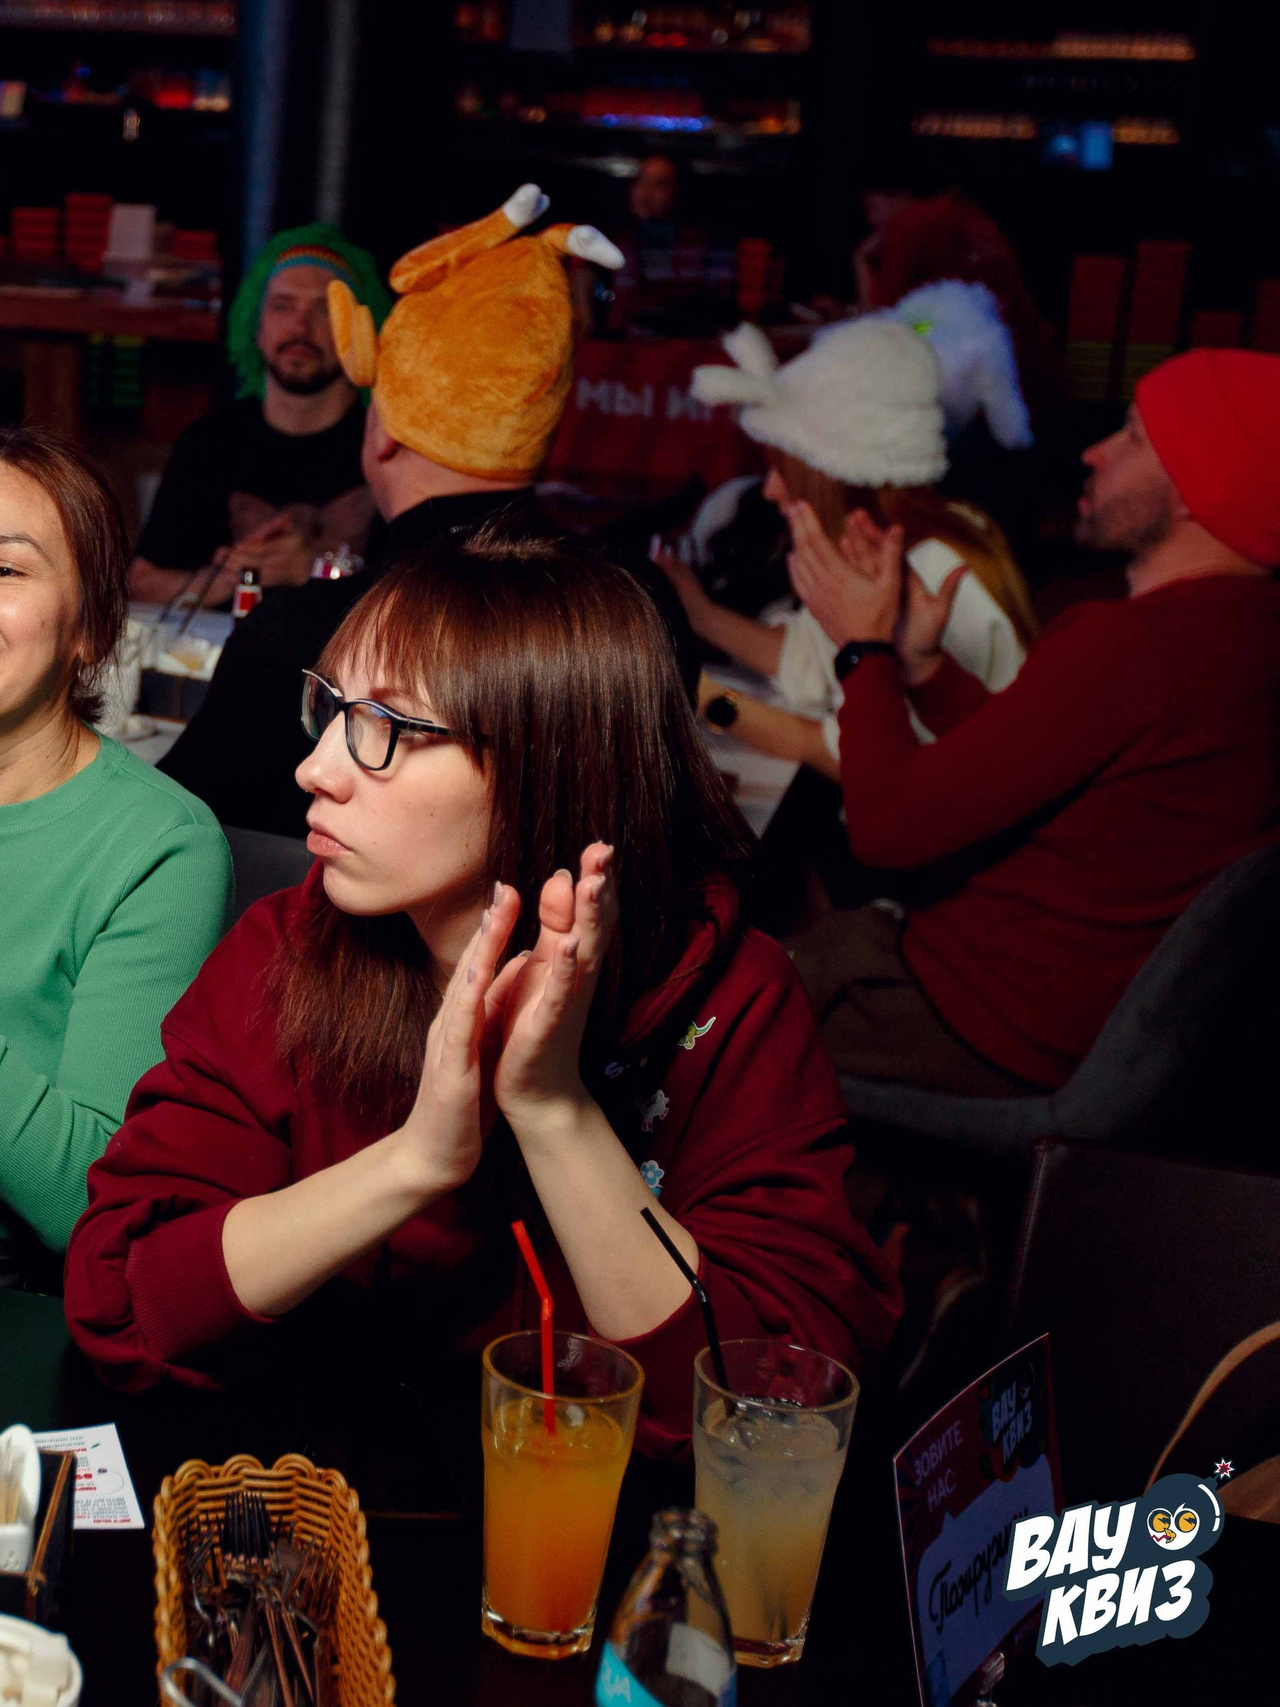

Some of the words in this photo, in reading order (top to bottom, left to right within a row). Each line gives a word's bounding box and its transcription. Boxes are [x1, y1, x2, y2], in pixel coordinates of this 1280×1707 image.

[576, 376, 654, 420] МЫ
[992, 1380, 1017, 1444] ВАУ
[1002, 1400, 1032, 1465] КВИЗ
[914, 1419, 963, 1487] ЗОВИТЕ
